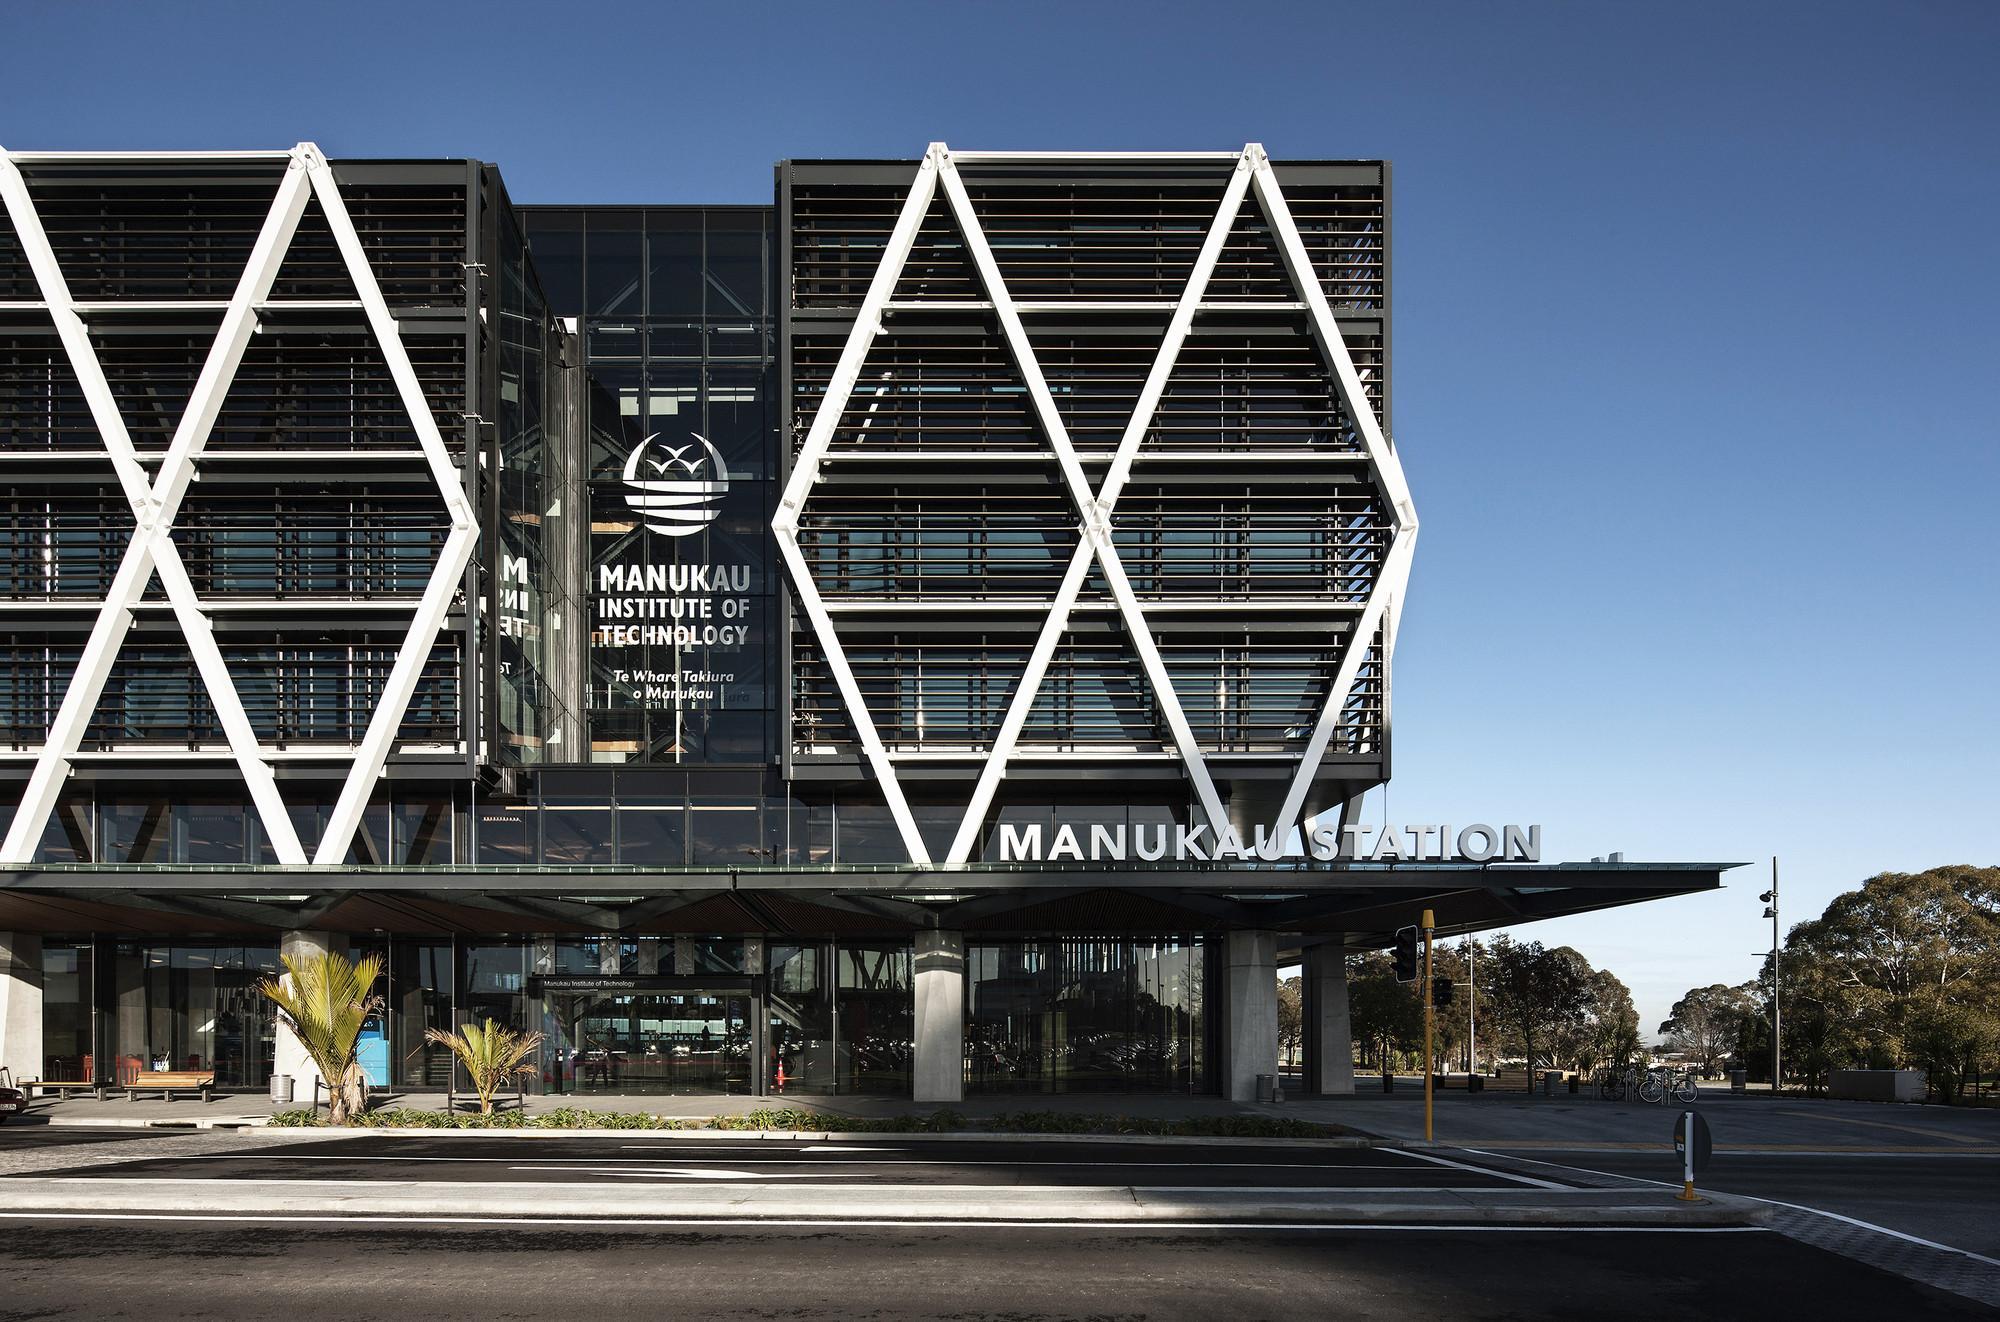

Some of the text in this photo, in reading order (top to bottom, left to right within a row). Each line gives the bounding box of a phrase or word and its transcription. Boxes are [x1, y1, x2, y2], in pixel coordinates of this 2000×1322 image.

[600, 564, 750, 592] MANUKAU
[600, 598, 750, 618] INSTITUTE OF
[599, 625, 749, 645] TECHNOLOGY
[613, 669, 734, 682] Te Whare Takiura
[632, 687, 714, 699] o Manukau
[999, 823, 1541, 863] MANUKAU STATION
